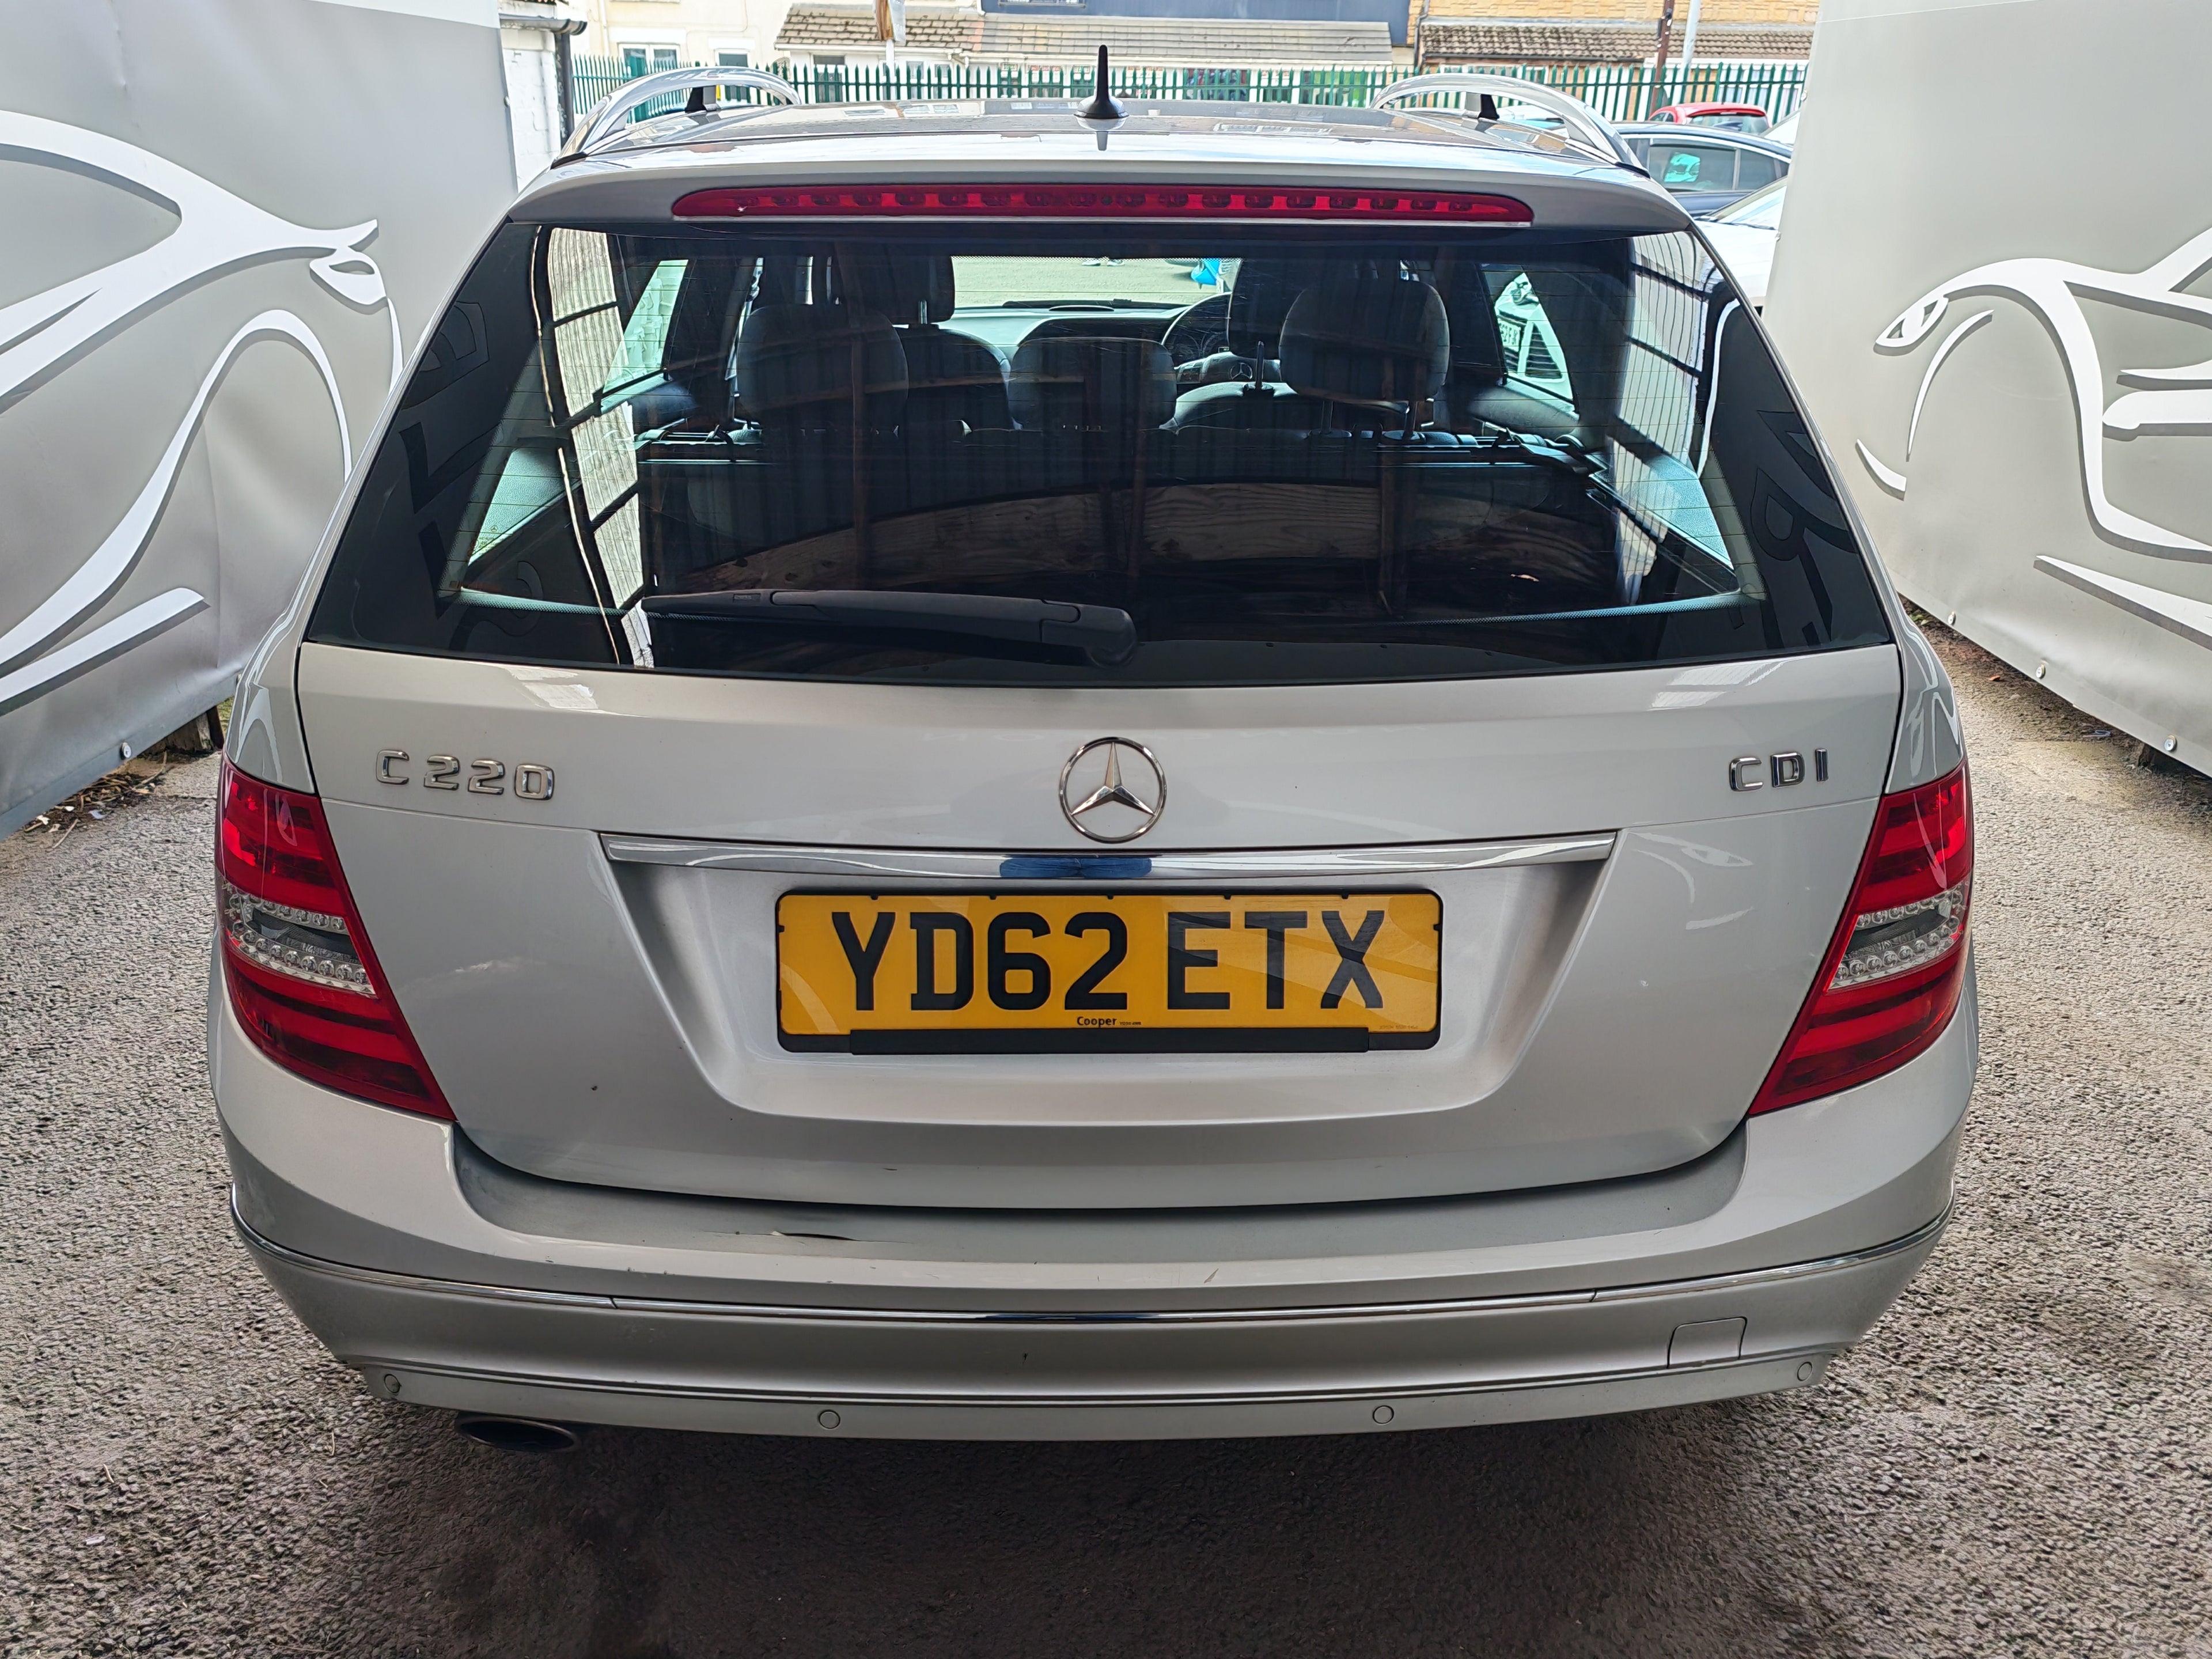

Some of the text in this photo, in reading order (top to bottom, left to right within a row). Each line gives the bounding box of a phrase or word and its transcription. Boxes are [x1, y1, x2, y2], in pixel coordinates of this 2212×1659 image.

[376, 749, 555, 801] C 220
[1729, 748, 1829, 791] CDI
[832, 910, 1385, 1010] YD62 ETX
[1077, 1016, 1118, 1027] Cooper
